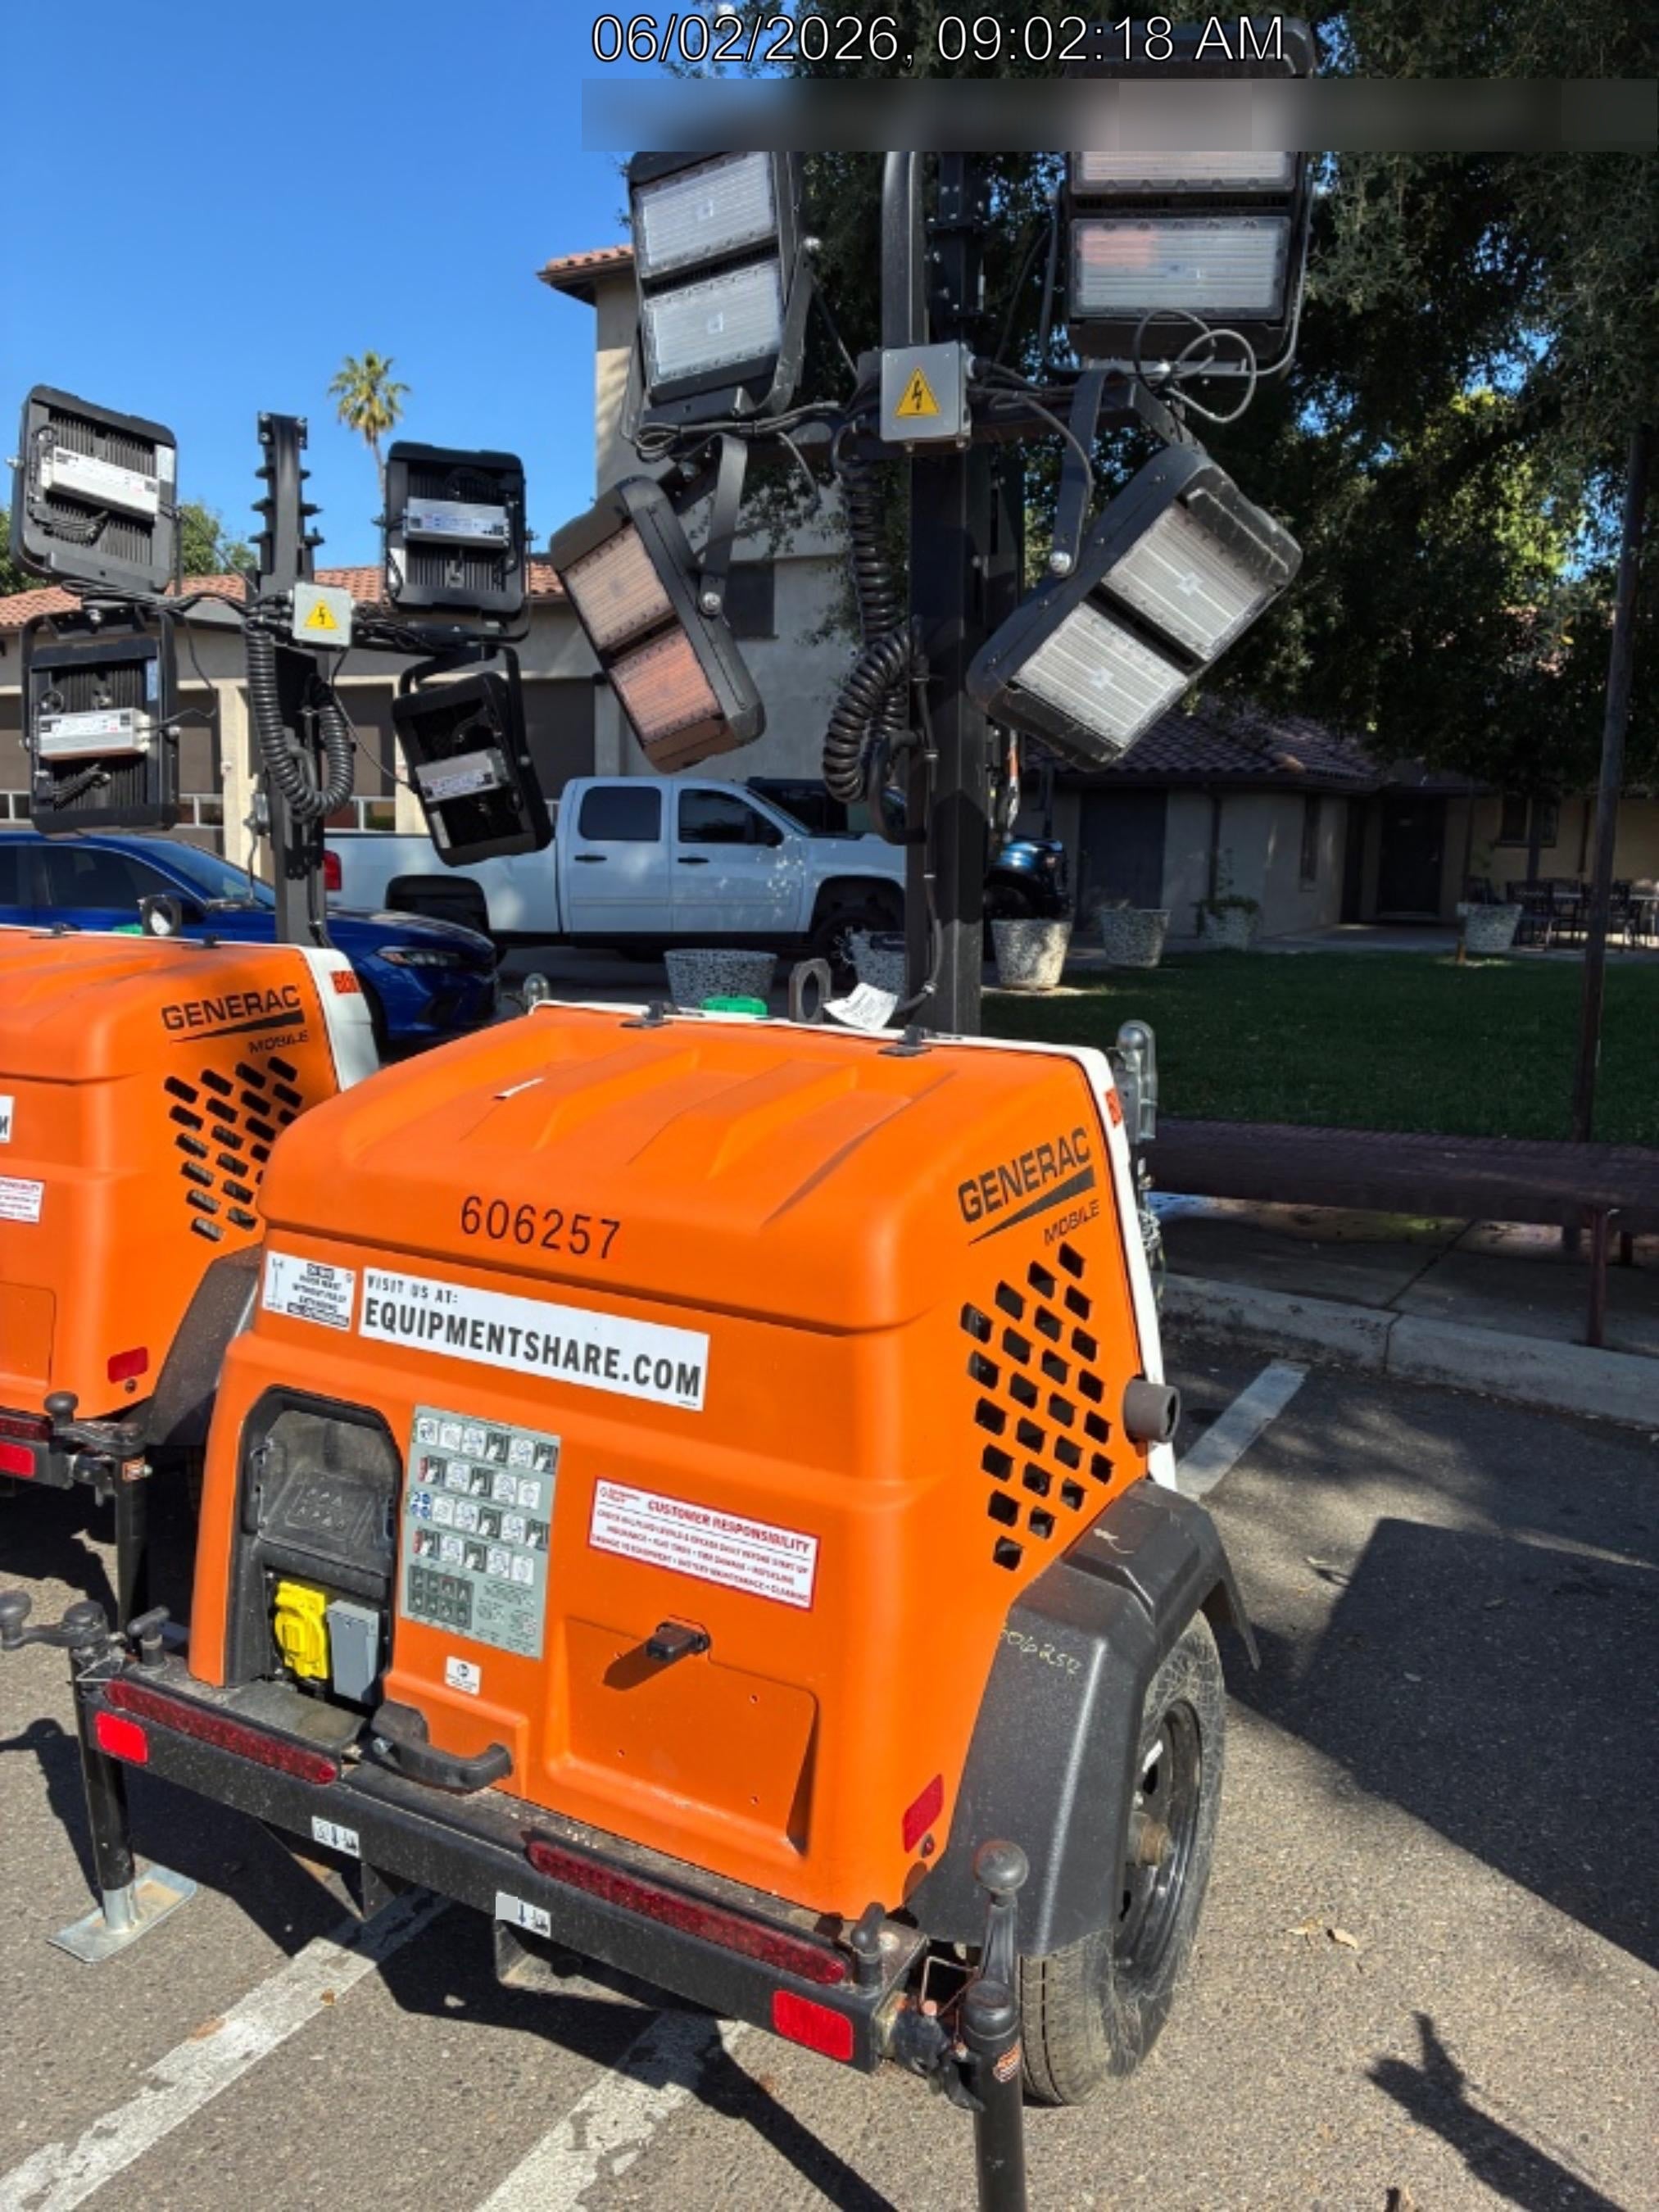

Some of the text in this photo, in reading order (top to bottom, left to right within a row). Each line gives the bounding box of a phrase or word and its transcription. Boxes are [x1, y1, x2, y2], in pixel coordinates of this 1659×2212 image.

[161, 986, 301, 1031] GENERAC
[248, 1030, 310, 1054] MOBILE
[958, 1127, 1090, 1224] GENERAC
[460, 1196, 620, 1259] 606257
[1044, 1199, 1100, 1246] MOBILE
[367, 1275, 459, 1304] VISIT US AT:
[365, 1297, 702, 1397] EQUIPMENTSHARE.COM
[647, 1499, 811, 1555] CUSTOMER RESPONSIBILITY
